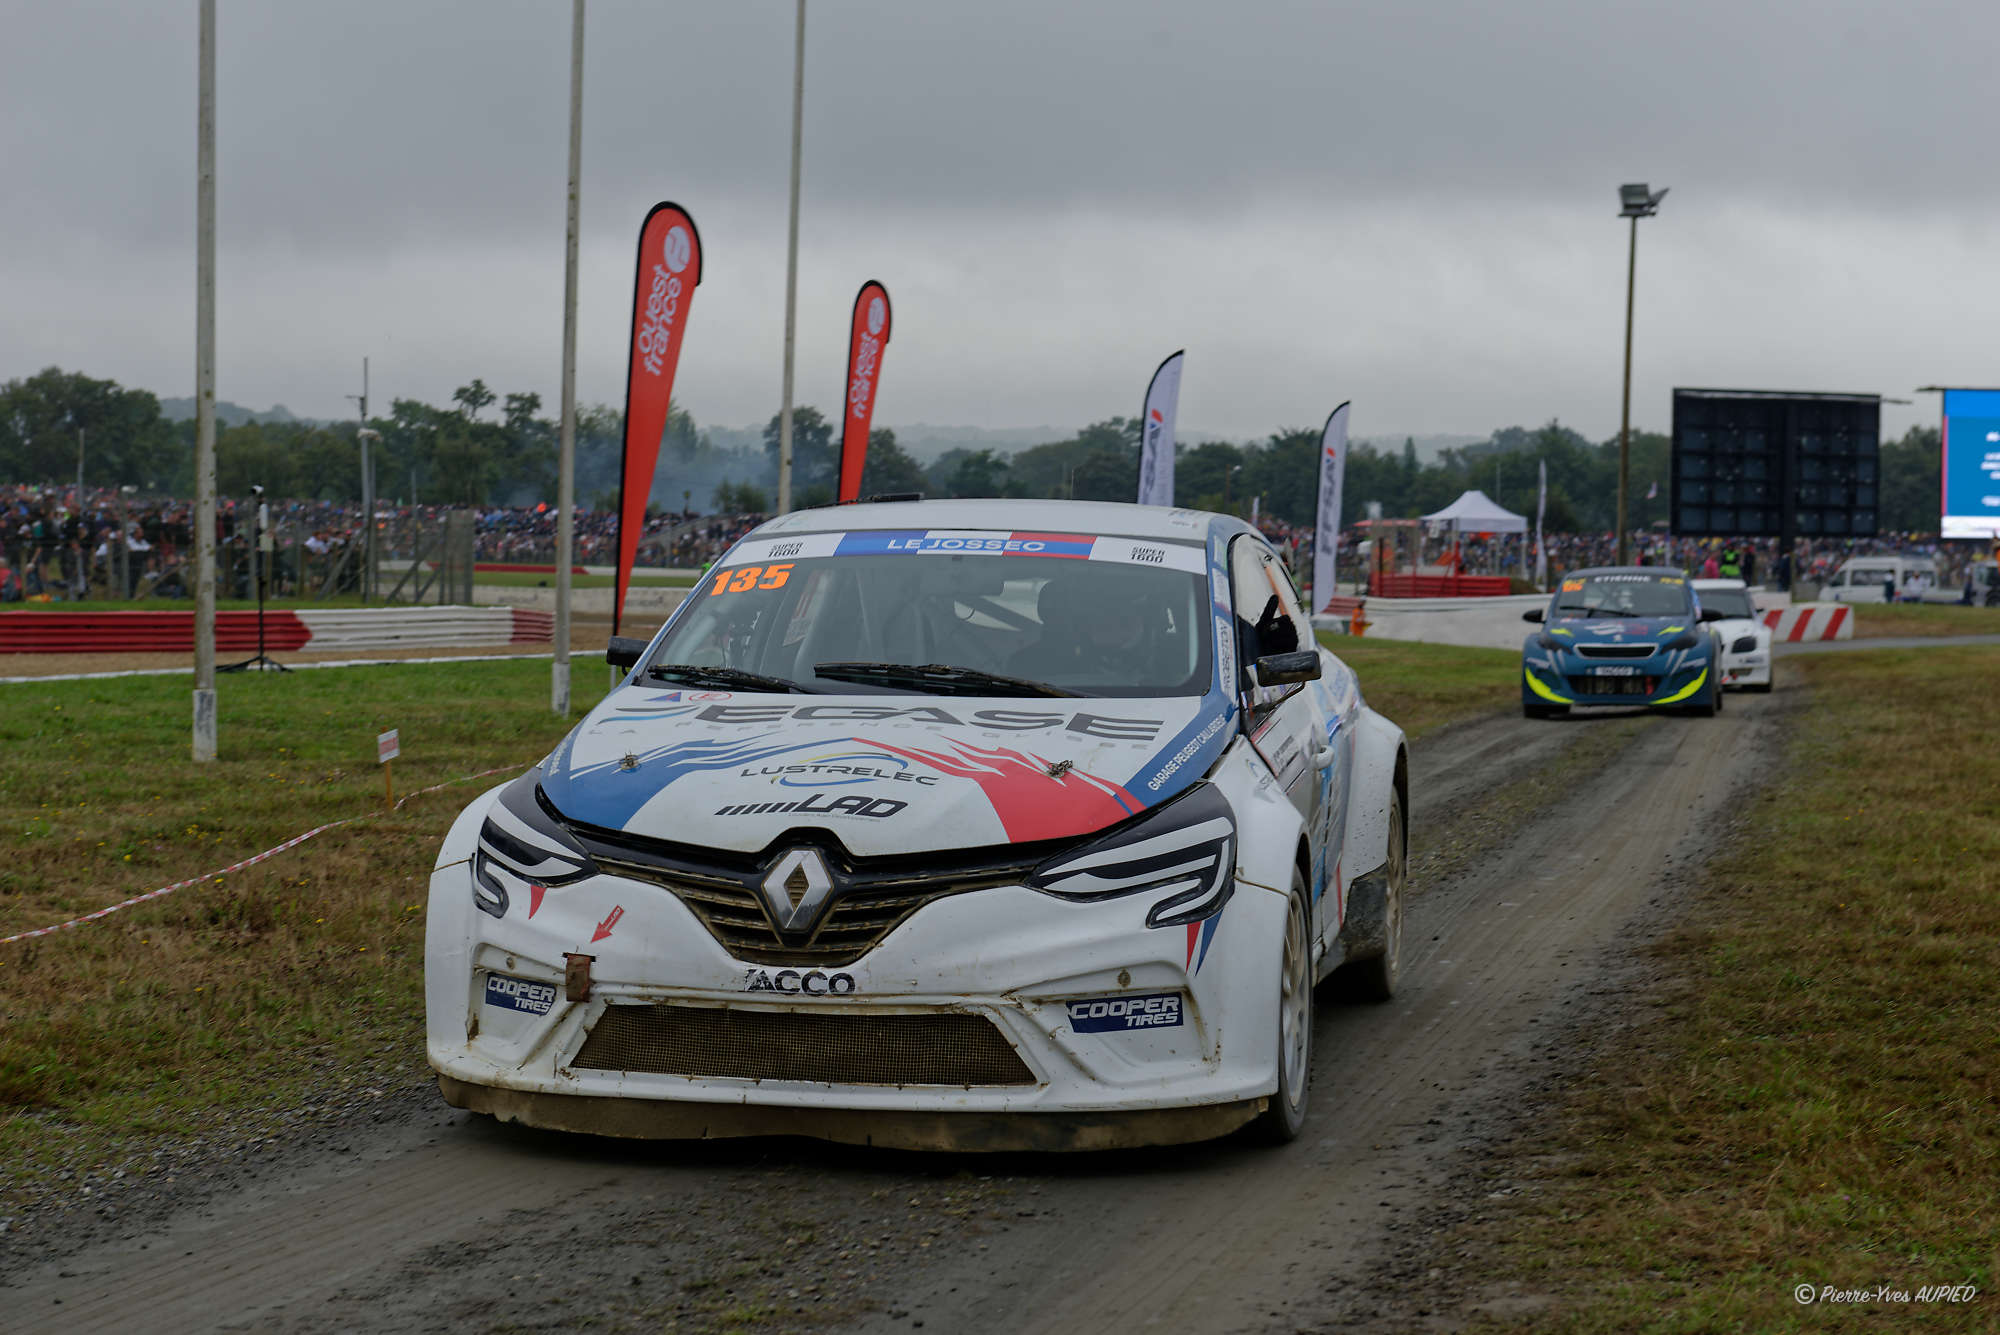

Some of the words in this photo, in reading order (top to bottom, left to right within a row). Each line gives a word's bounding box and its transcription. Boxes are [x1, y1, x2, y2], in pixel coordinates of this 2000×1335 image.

[638, 264, 671, 353] ouest
[644, 277, 681, 376] france
[768, 549, 800, 558] 1600
[772, 542, 804, 551] SUPER
[888, 539, 923, 549] LE
[925, 539, 1046, 552] JOSSEC
[1131, 545, 1166, 557] SUPER
[1130, 552, 1164, 563] 1600
[711, 563, 795, 596] 135
[1148, 760, 1180, 791] GARAGE
[1173, 738, 1201, 766] PEUGEOT
[741, 765, 940, 786] LUSTRELEC
[792, 793, 909, 818] LAD
[487, 977, 556, 1001] COOPER
[515, 997, 551, 1013] TIRES
[1069, 996, 1180, 1020] COOPER
[1125, 1012, 1178, 1027] TIRES
